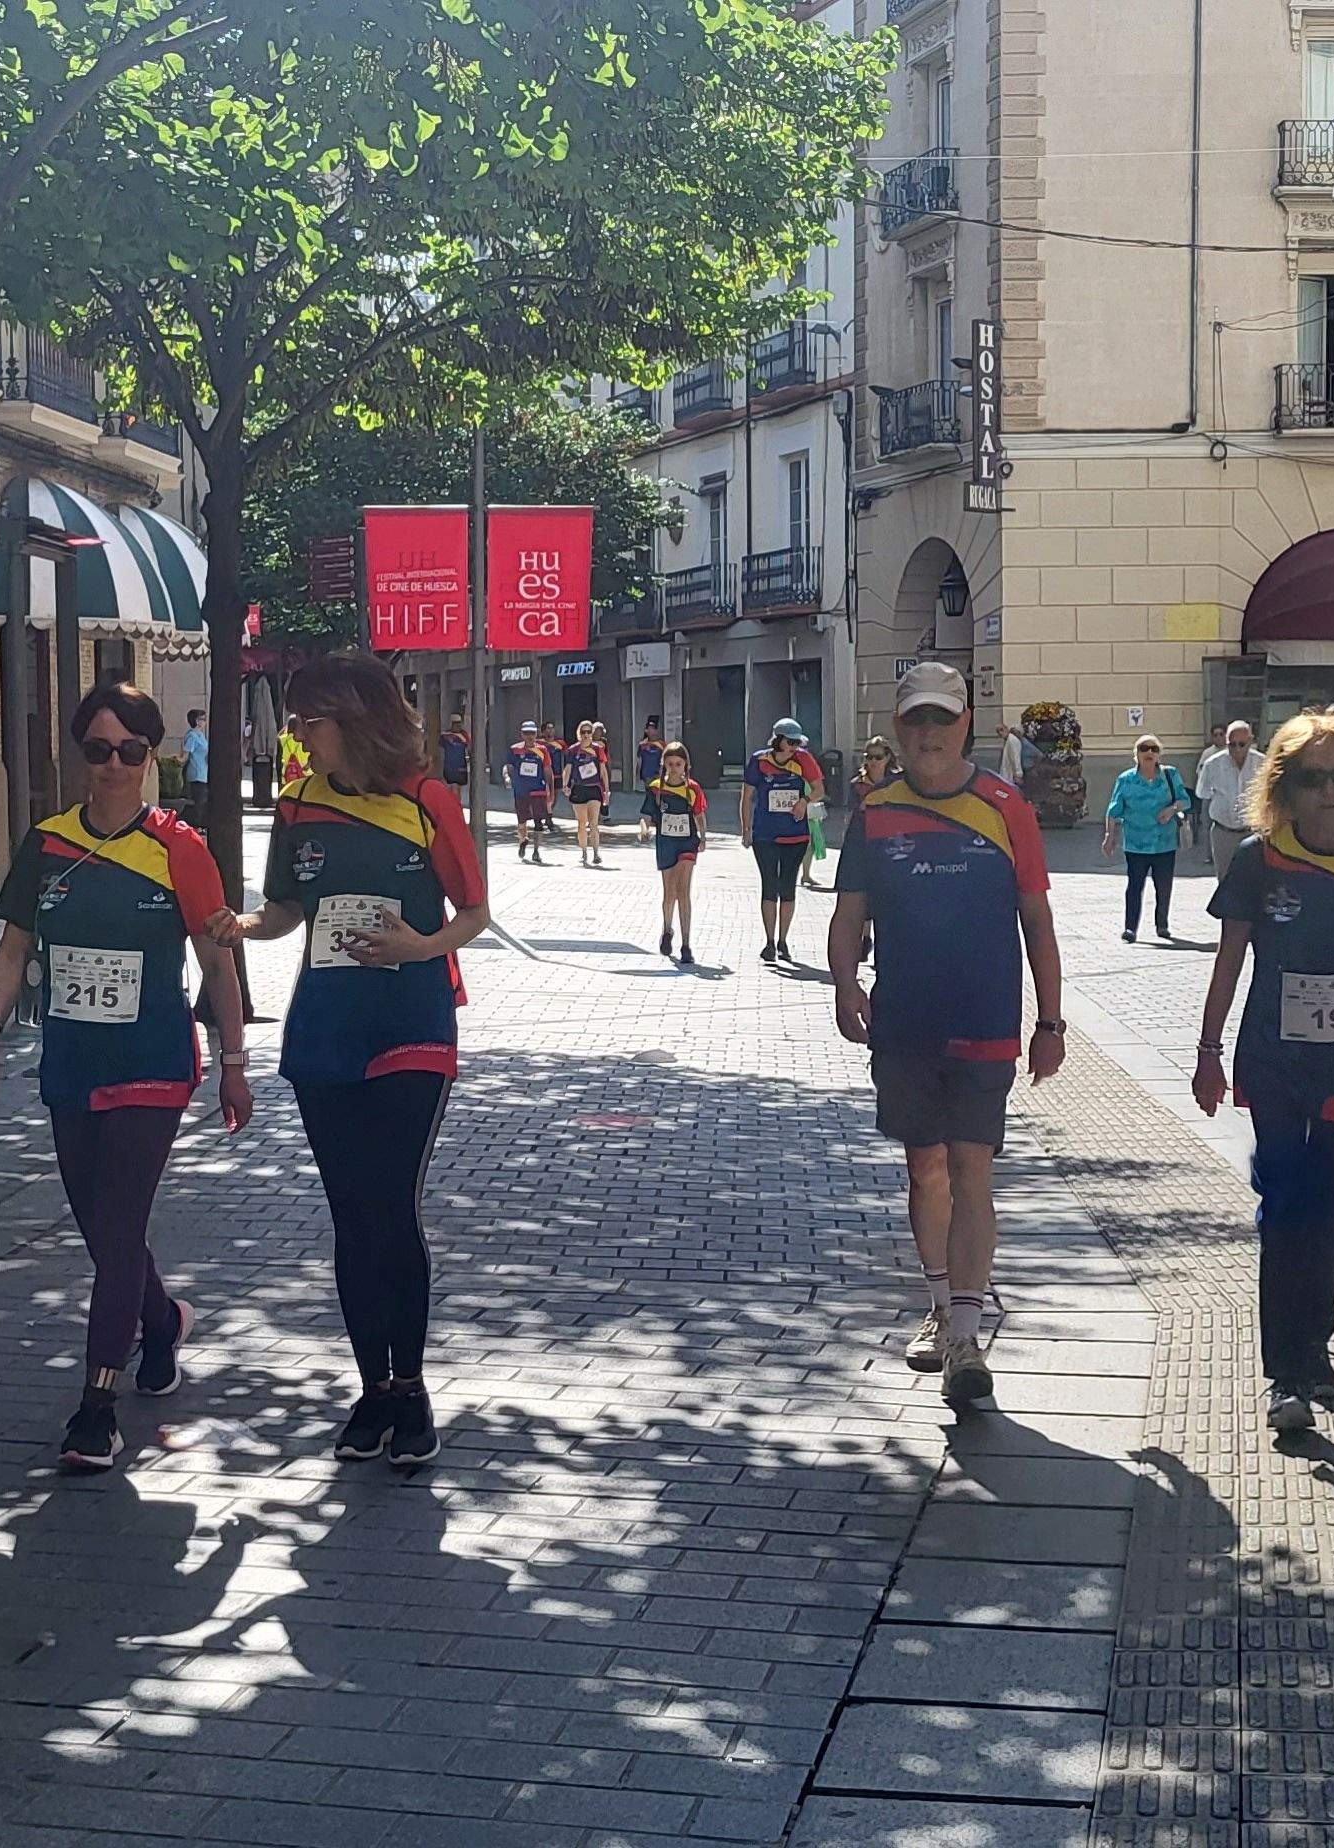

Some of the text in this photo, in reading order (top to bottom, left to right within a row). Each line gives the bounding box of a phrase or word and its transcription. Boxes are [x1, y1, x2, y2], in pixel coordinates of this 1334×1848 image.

[978, 323, 995, 480] HOSTAL
[376, 581, 458, 592] DE CINE DE HUESCA
[518, 572, 561, 600] es
[376, 603, 459, 636] HIFF
[518, 611, 562, 637] ca
[934, 862, 968, 874] mupol
[65, 982, 119, 1008] 215
